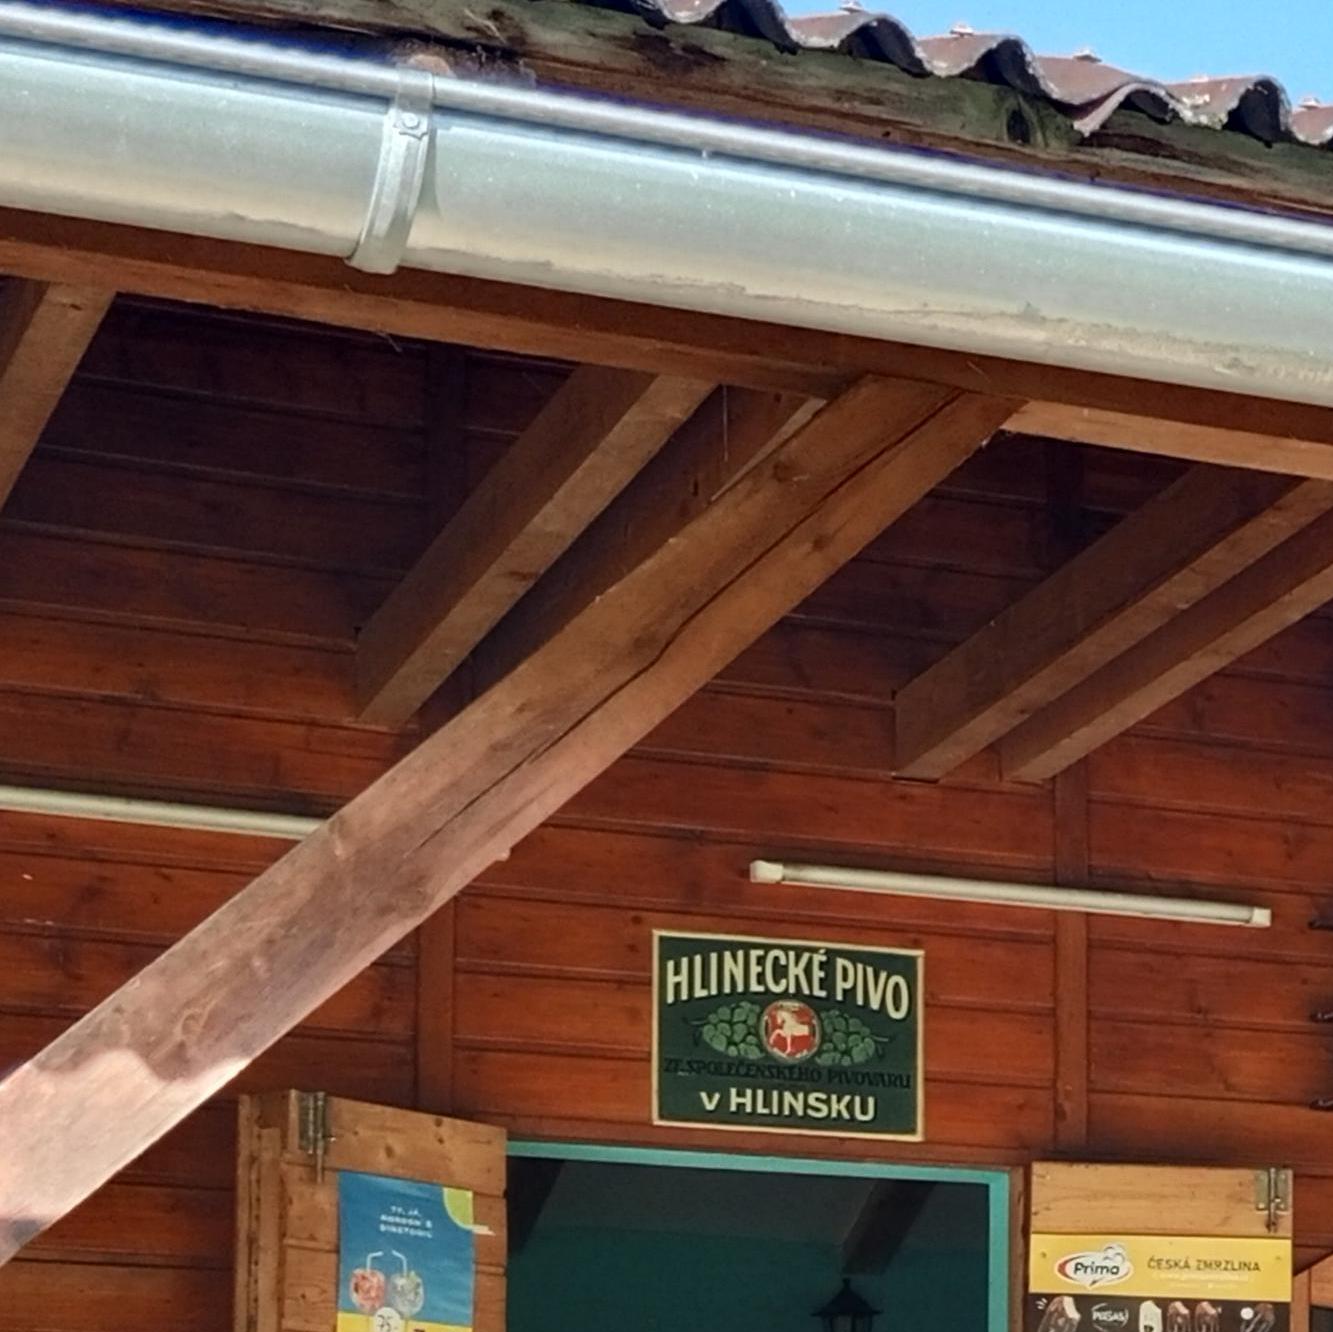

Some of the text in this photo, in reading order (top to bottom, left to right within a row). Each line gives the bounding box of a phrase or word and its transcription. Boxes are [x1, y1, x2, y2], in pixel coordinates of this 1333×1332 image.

[666, 949, 909, 1020] HLINECKÉ PIVO
[729, 1087, 875, 1121] HLINSKU
[1147, 1255, 1191, 1270] ČESKÁ
[1195, 1259, 1262, 1272] ZMRZLINA
